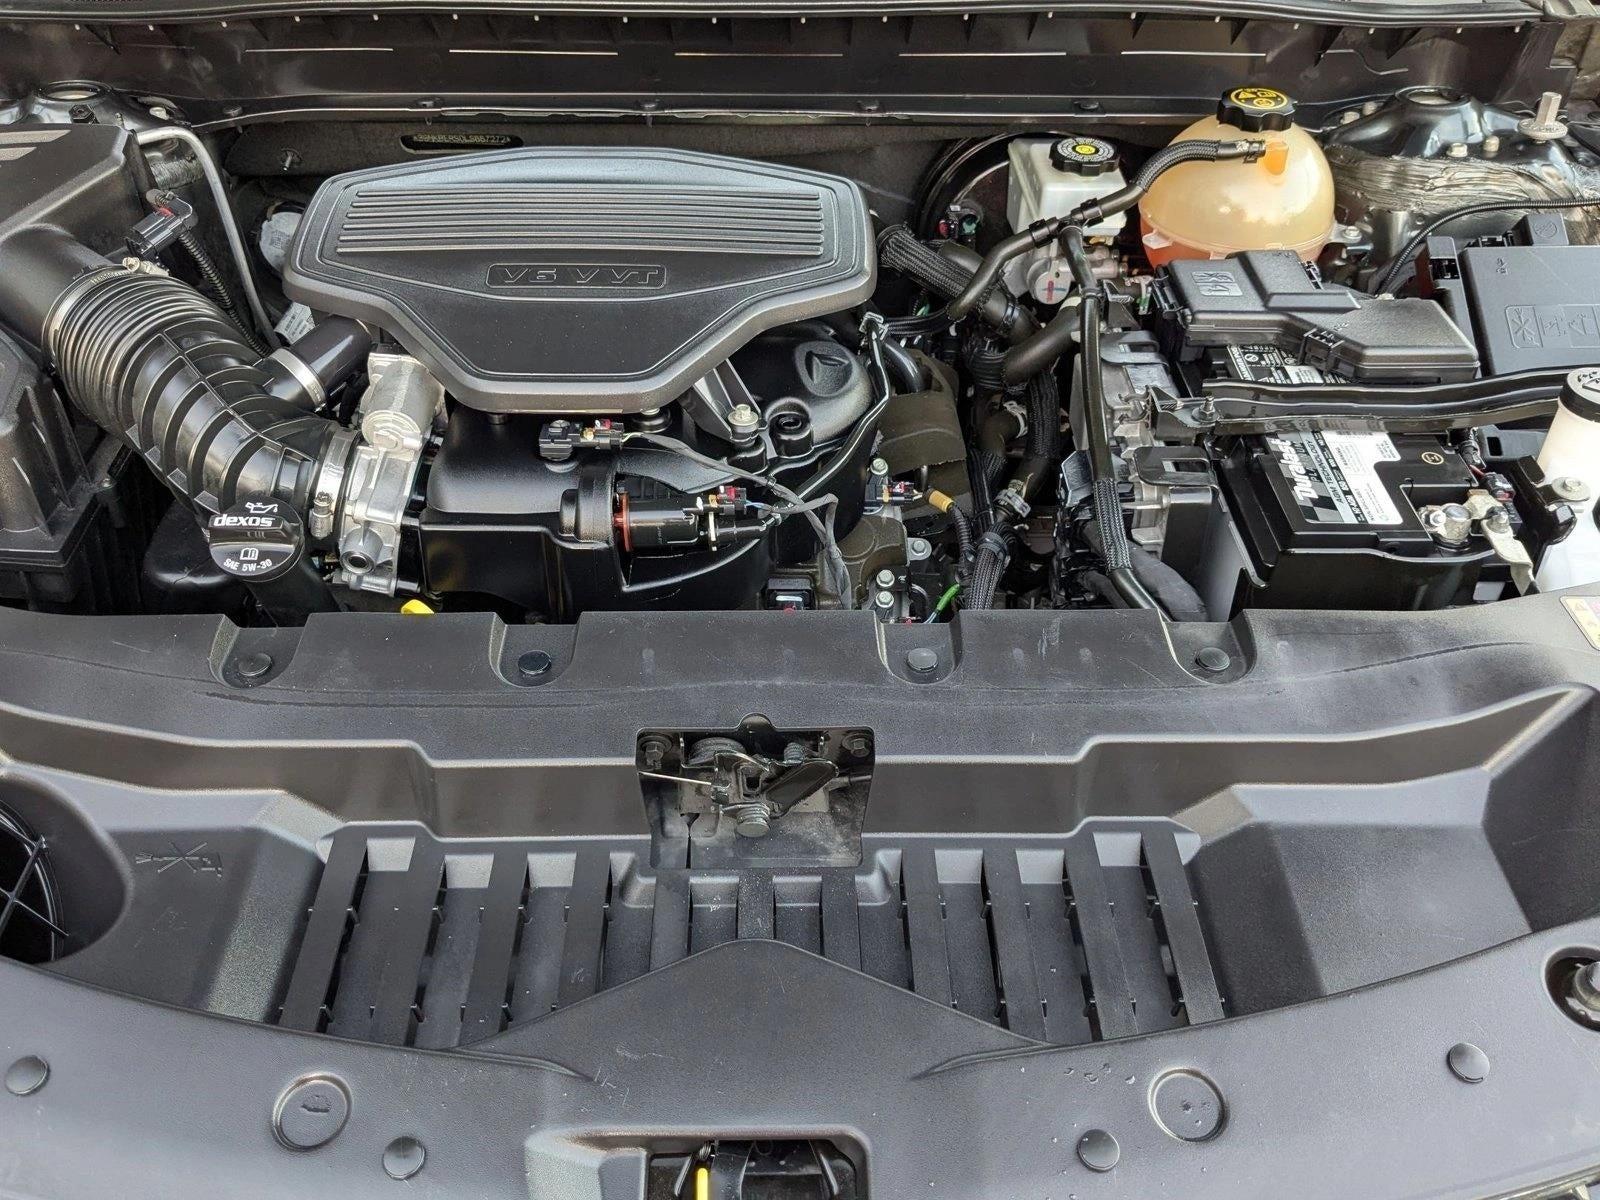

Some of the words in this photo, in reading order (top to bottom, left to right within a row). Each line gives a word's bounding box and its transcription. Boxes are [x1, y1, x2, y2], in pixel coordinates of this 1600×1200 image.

[504, 267, 558, 283] V6
[1269, 437, 1319, 501] Duralast
[1292, 440, 1318, 482] PLANUM
[1306, 440, 1334, 484] TECHNOLOGY
[1329, 486, 1344, 504] AGM
[213, 513, 276, 527] dexos
[223, 558, 240, 571] SAE
[241, 558, 273, 572] 5W-30
